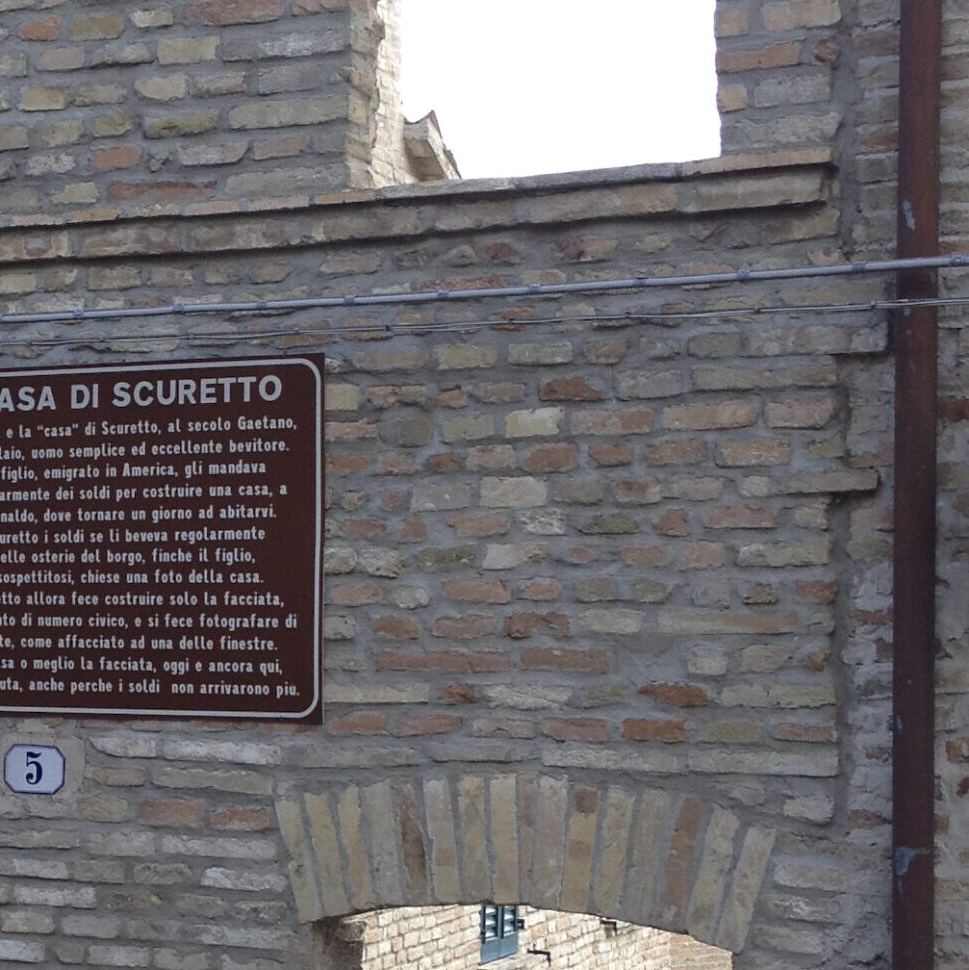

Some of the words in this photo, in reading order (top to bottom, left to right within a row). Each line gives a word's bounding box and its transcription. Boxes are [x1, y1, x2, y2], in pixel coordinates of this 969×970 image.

[70, 383, 99, 410] DI
[111, 374, 283, 408] SCURETTO
[19, 424, 32, 439] la
[84, 421, 96, 436] di
[101, 420, 162, 436] Scuretto,
[167, 418, 181, 433] al
[187, 416, 231, 432] secolo
[237, 415, 297, 431] Gaetano,
[31, 448, 64, 460] uomo
[69, 442, 126, 461] semplice
[131, 441, 146, 456] ed
[151, 439, 223, 456] eccellente
[229, 437, 290, 453] bevitore.
[0, 465, 38, 484] figlio,
[43, 464, 100, 482] emigrato
[105, 463, 117, 478] in
[122, 462, 179, 477] America,
[184, 460, 203, 479] gli
[208, 459, 266, 475] mandava
[55, 486, 74, 501] dei
[79, 485, 111, 500] soldi
[115, 488, 137, 502] per
[142, 483, 203, 499] costruire
[209, 485, 232, 497] una
[238, 484, 273, 498] casa,
[279, 484, 288, 495] a
[43, 508, 72, 522] dove
[77, 507, 125, 522] tornare
[131, 510, 146, 521] un
[151, 505, 193, 524] giorno
[198, 504, 214, 519] ad
[219, 503, 277, 519] abitarvi.
[44, 529, 49, 544] i
[53, 528, 85, 544] soldi
[89, 532, 104, 543] se
[109, 528, 120, 543] li
[125, 528, 168, 543] beveva
[174, 525, 266, 545] regolarmente
[31, 549, 76, 564] osterie
[80, 548, 101, 563] del
[106, 549, 146, 566] borgo,
[198, 547, 209, 563] il
[215, 547, 256, 566] figlio,
[80, 569, 120, 584] chiese
[126, 572, 149, 584] una
[154, 568, 183, 584] foto
[188, 568, 224, 584] della
[229, 572, 264, 584] casa.
[26, 591, 66, 605] allora
[71, 591, 99, 606] fece
[104, 591, 164, 606] costruire
[169, 591, 198, 606] solo
[203, 591, 218, 606] la
[223, 590, 285, 608] facciata,
[21, 612, 32, 627] di
[37, 616, 83, 627] numero
[88, 612, 129, 629] civico,
[134, 617, 142, 628] e
[148, 613, 159, 628] si
[164, 613, 193, 628] fece
[199, 613, 279, 632] fotografare
[285, 613, 297, 629] di
[20, 637, 53, 649] come
[57, 634, 125, 649] affacciato
[130, 635, 145, 649] ad
[151, 639, 173, 650] una
[179, 635, 214, 650] delle
[220, 635, 278, 651] finestre.
[20, 659, 28, 669] o
[33, 655, 75, 674] meglio
[80, 656, 94, 670] la
[99, 656, 157, 674] facciata,
[162, 657, 190, 676] oggi
[208, 661, 254, 673] ancora
[259, 658, 283, 677] qui,
[28, 677, 65, 692] anche
[118, 678, 123, 693] i
[128, 678, 160, 694] soldi
[171, 683, 194, 694] non
[199, 680, 270, 696] arrivarono
[25, 751, 43, 785] 5
